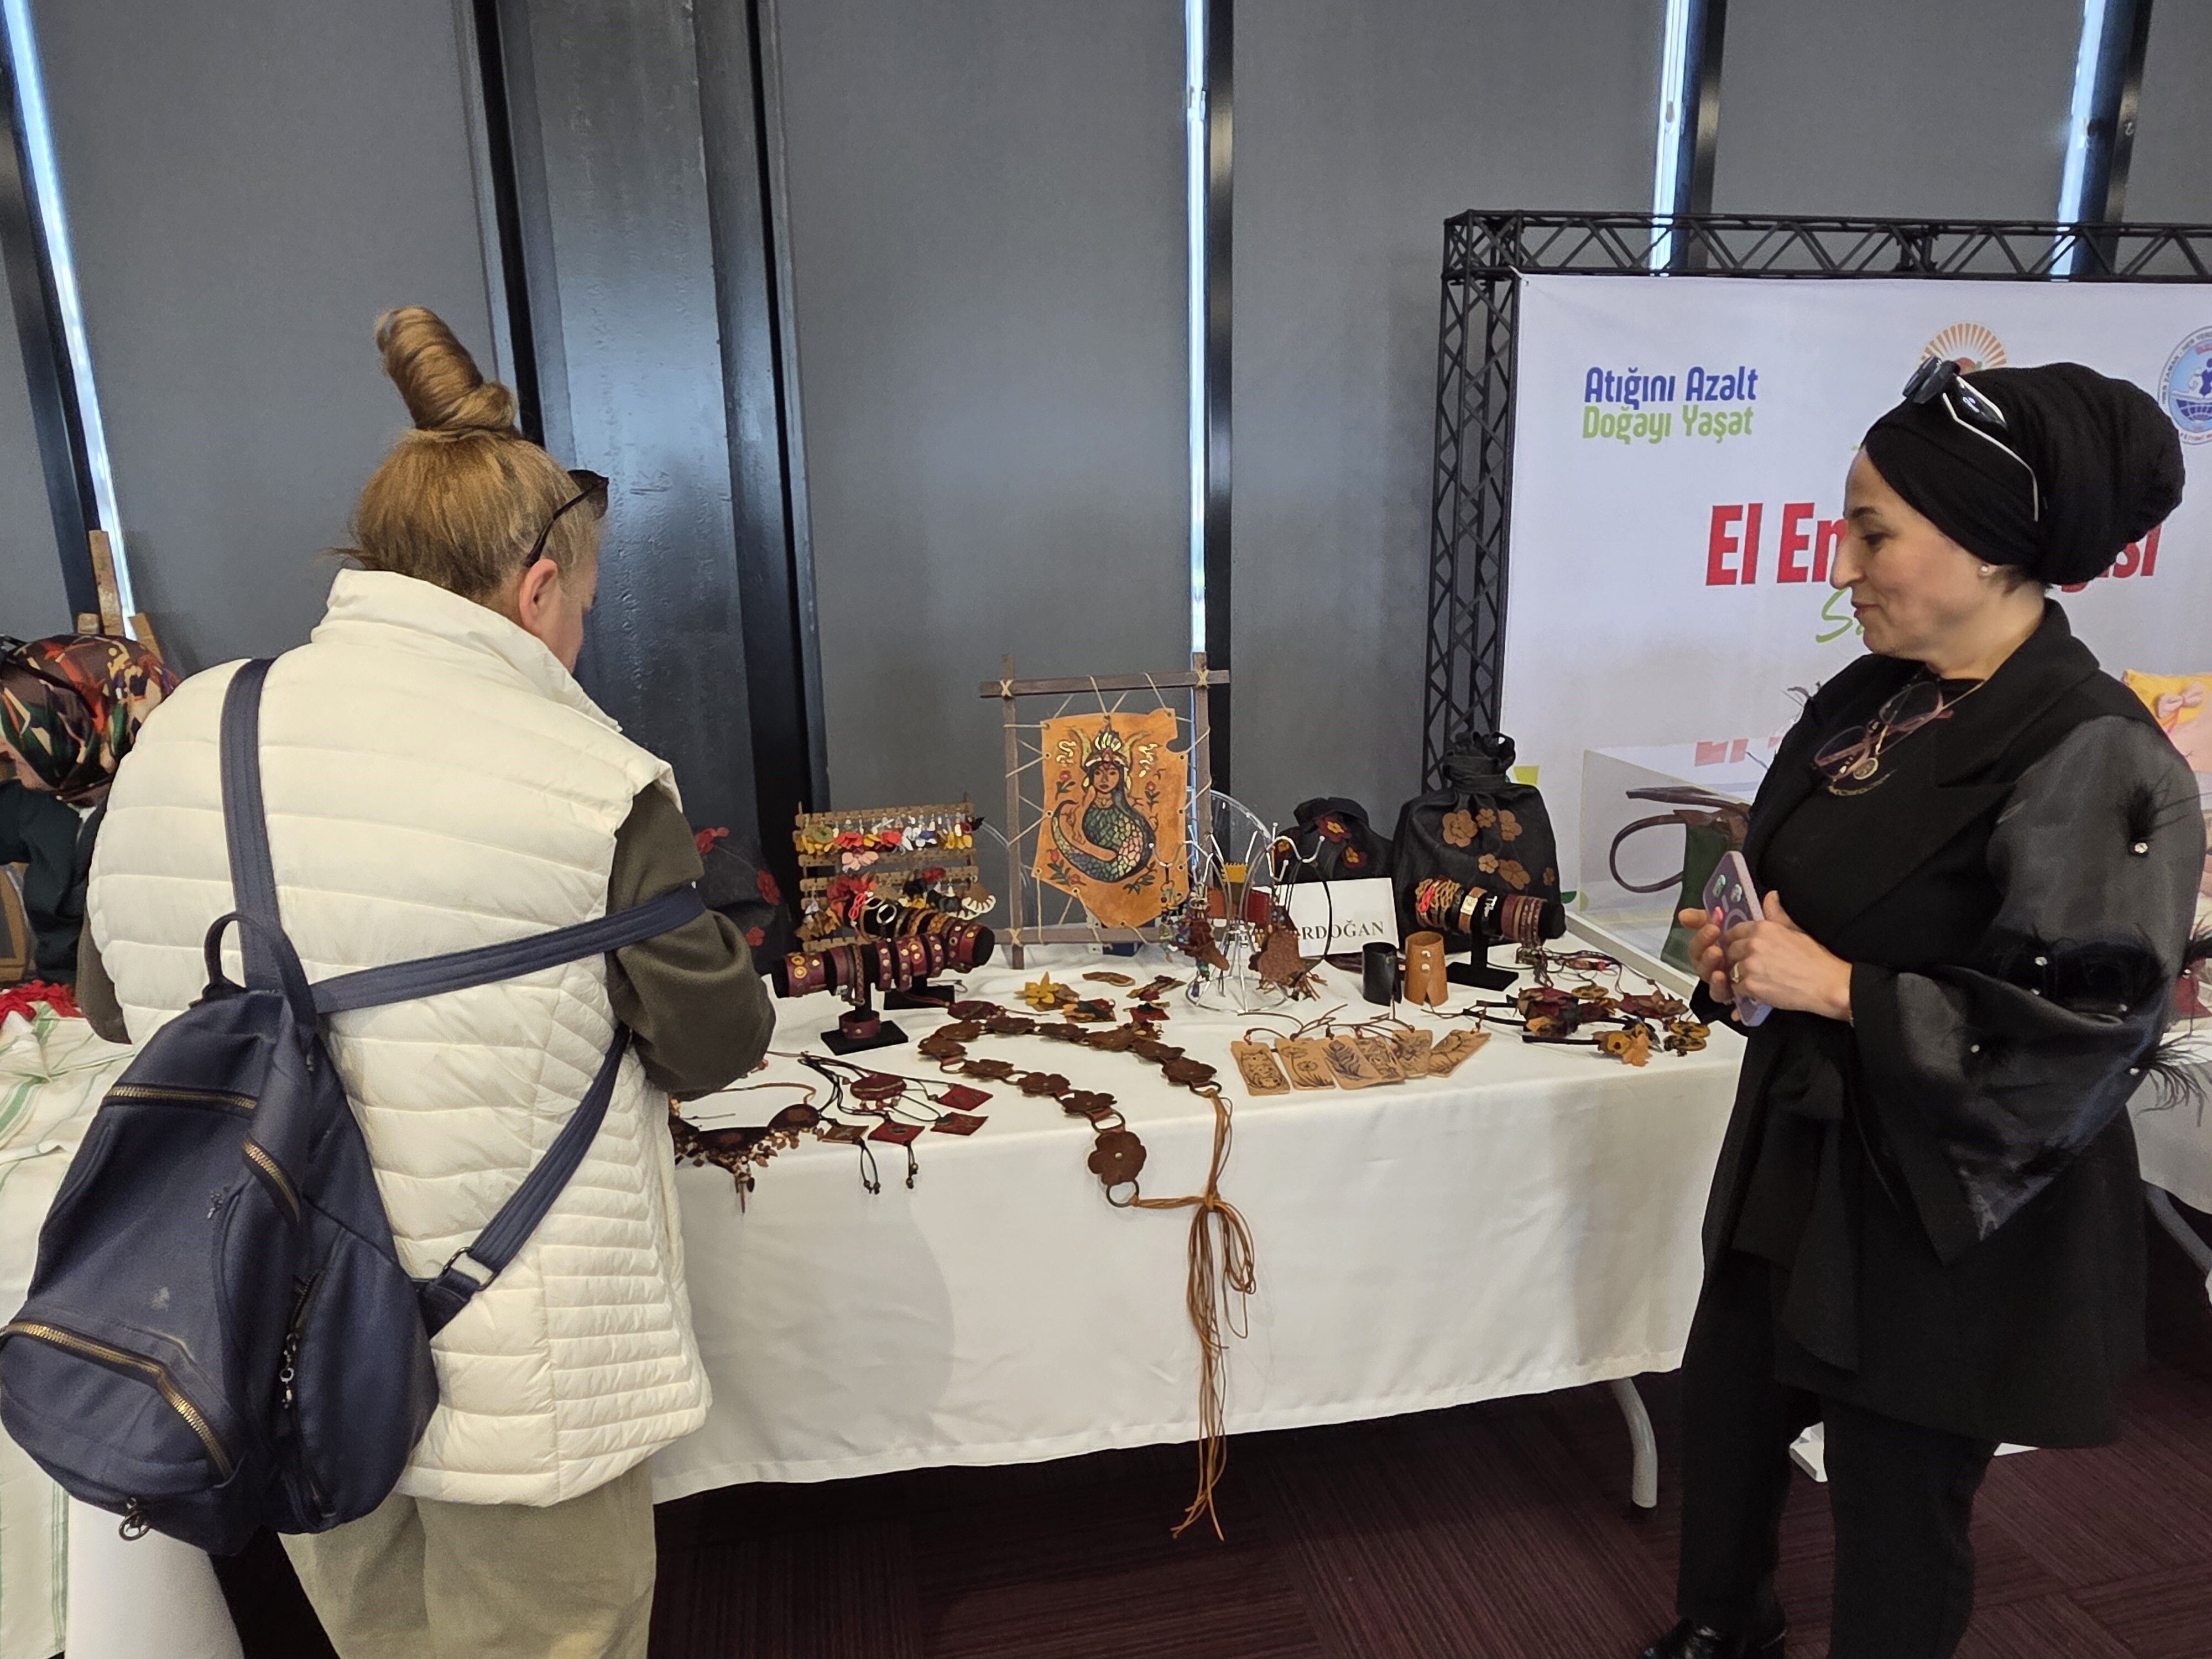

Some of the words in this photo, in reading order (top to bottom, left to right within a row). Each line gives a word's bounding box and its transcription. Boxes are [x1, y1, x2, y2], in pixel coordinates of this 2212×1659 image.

[1584, 367, 1676, 410] Atığını
[1685, 366, 1759, 401] Azalt
[1582, 405, 1672, 445] Doğayı
[1682, 404, 1754, 444] Yaşat
[1705, 502, 1763, 586] El
[1301, 919, 1384, 941] RDOĞAN
